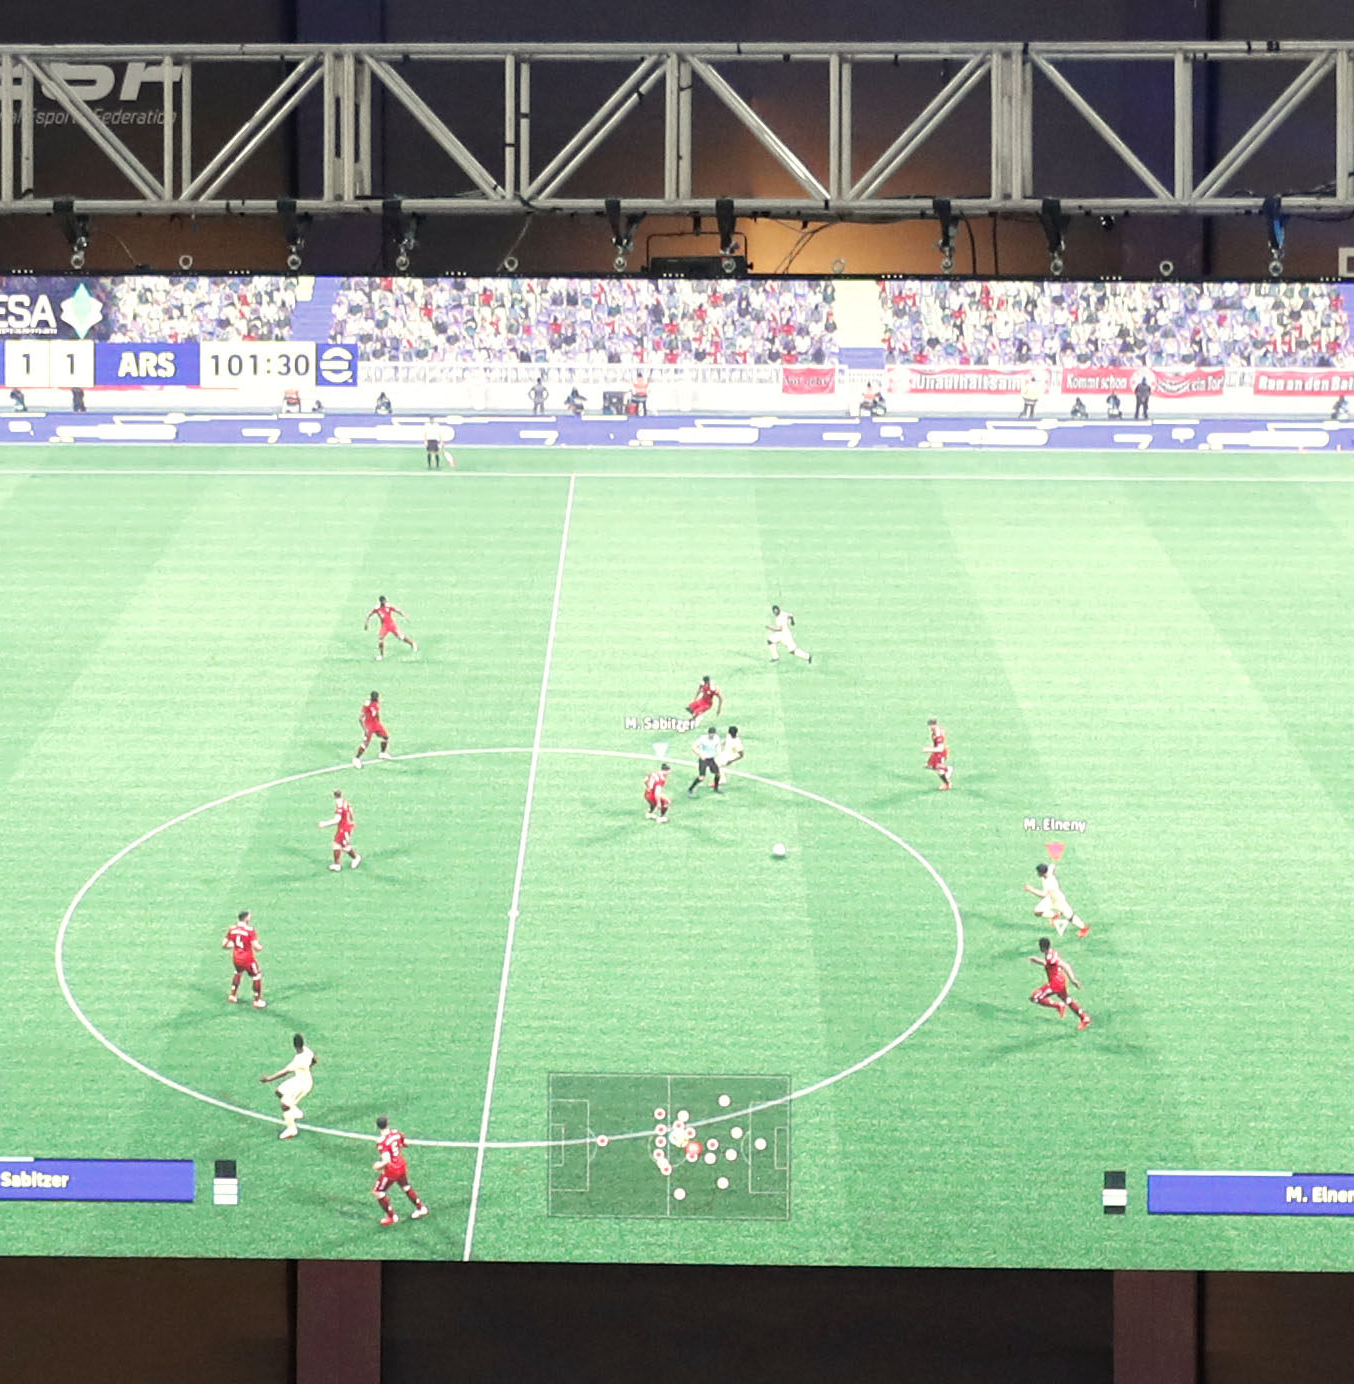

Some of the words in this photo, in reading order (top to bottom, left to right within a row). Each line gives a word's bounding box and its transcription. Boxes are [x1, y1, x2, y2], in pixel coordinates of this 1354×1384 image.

[22, 353, 32, 377] 1
[66, 353, 76, 377] 1
[117, 350, 177, 380] ARS
[210, 353, 311, 378] 101:30
[0, 1170, 70, 1188] Sabitzer
[1286, 1186, 1308, 1204] M.
